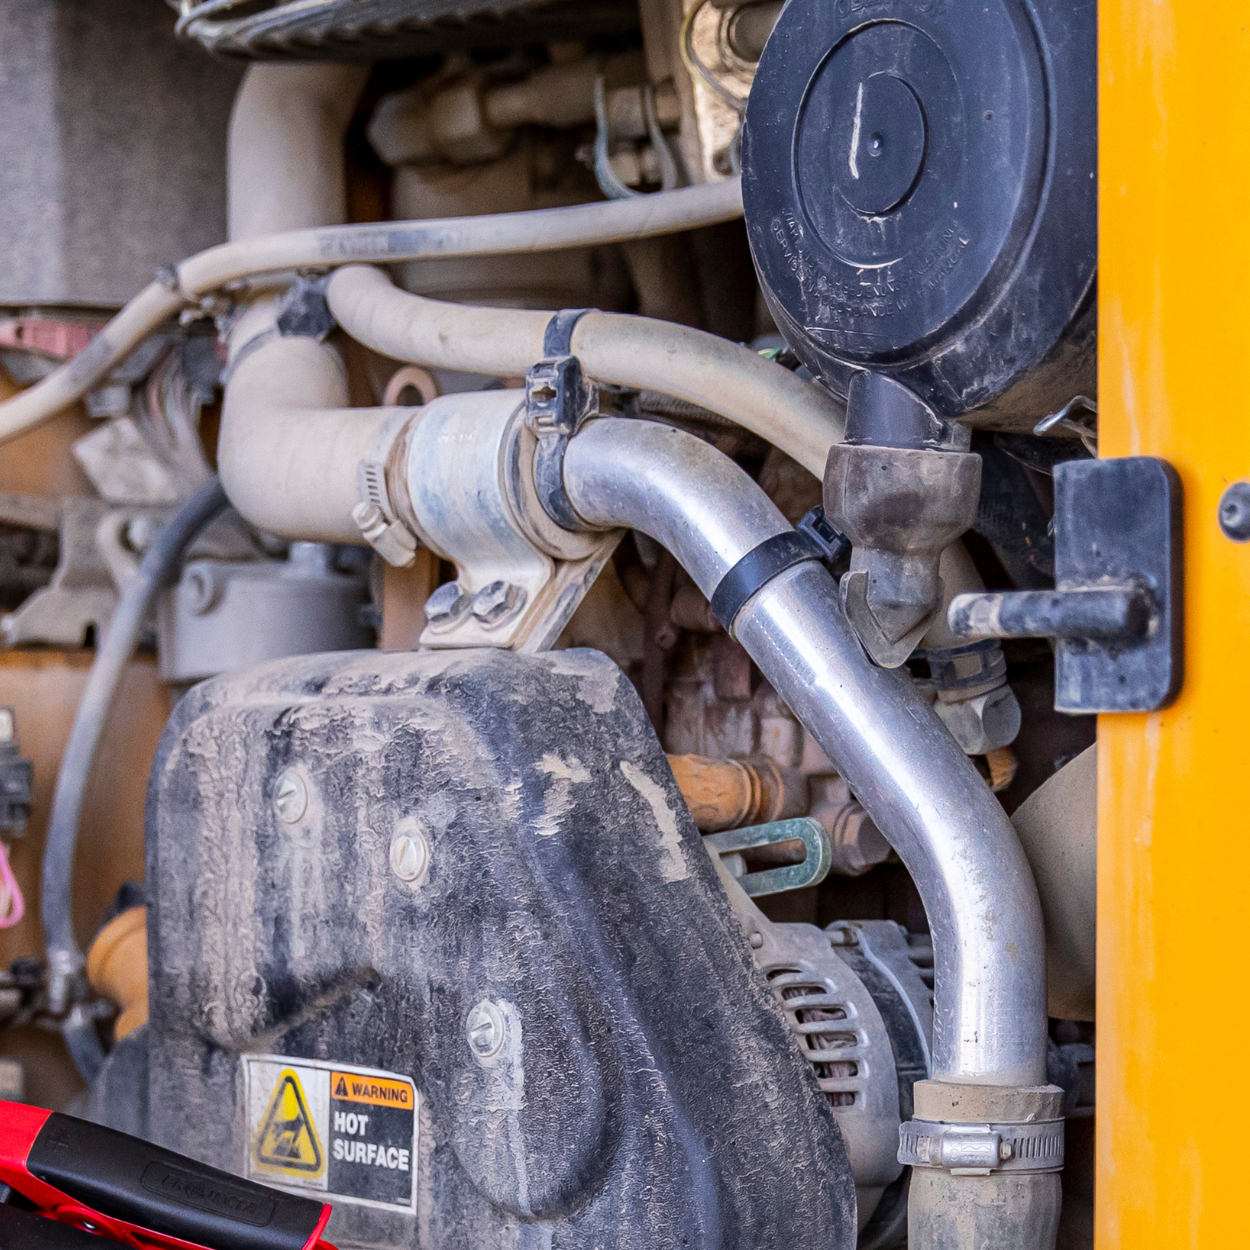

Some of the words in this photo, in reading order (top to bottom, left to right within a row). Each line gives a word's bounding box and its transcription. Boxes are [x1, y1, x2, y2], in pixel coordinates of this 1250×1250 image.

[770, 217, 805, 282] SERVICE
[352, 1082, 408, 1103] WARNING
[334, 1111, 369, 1136] HOT
[332, 1138, 410, 1172] SURFACE
